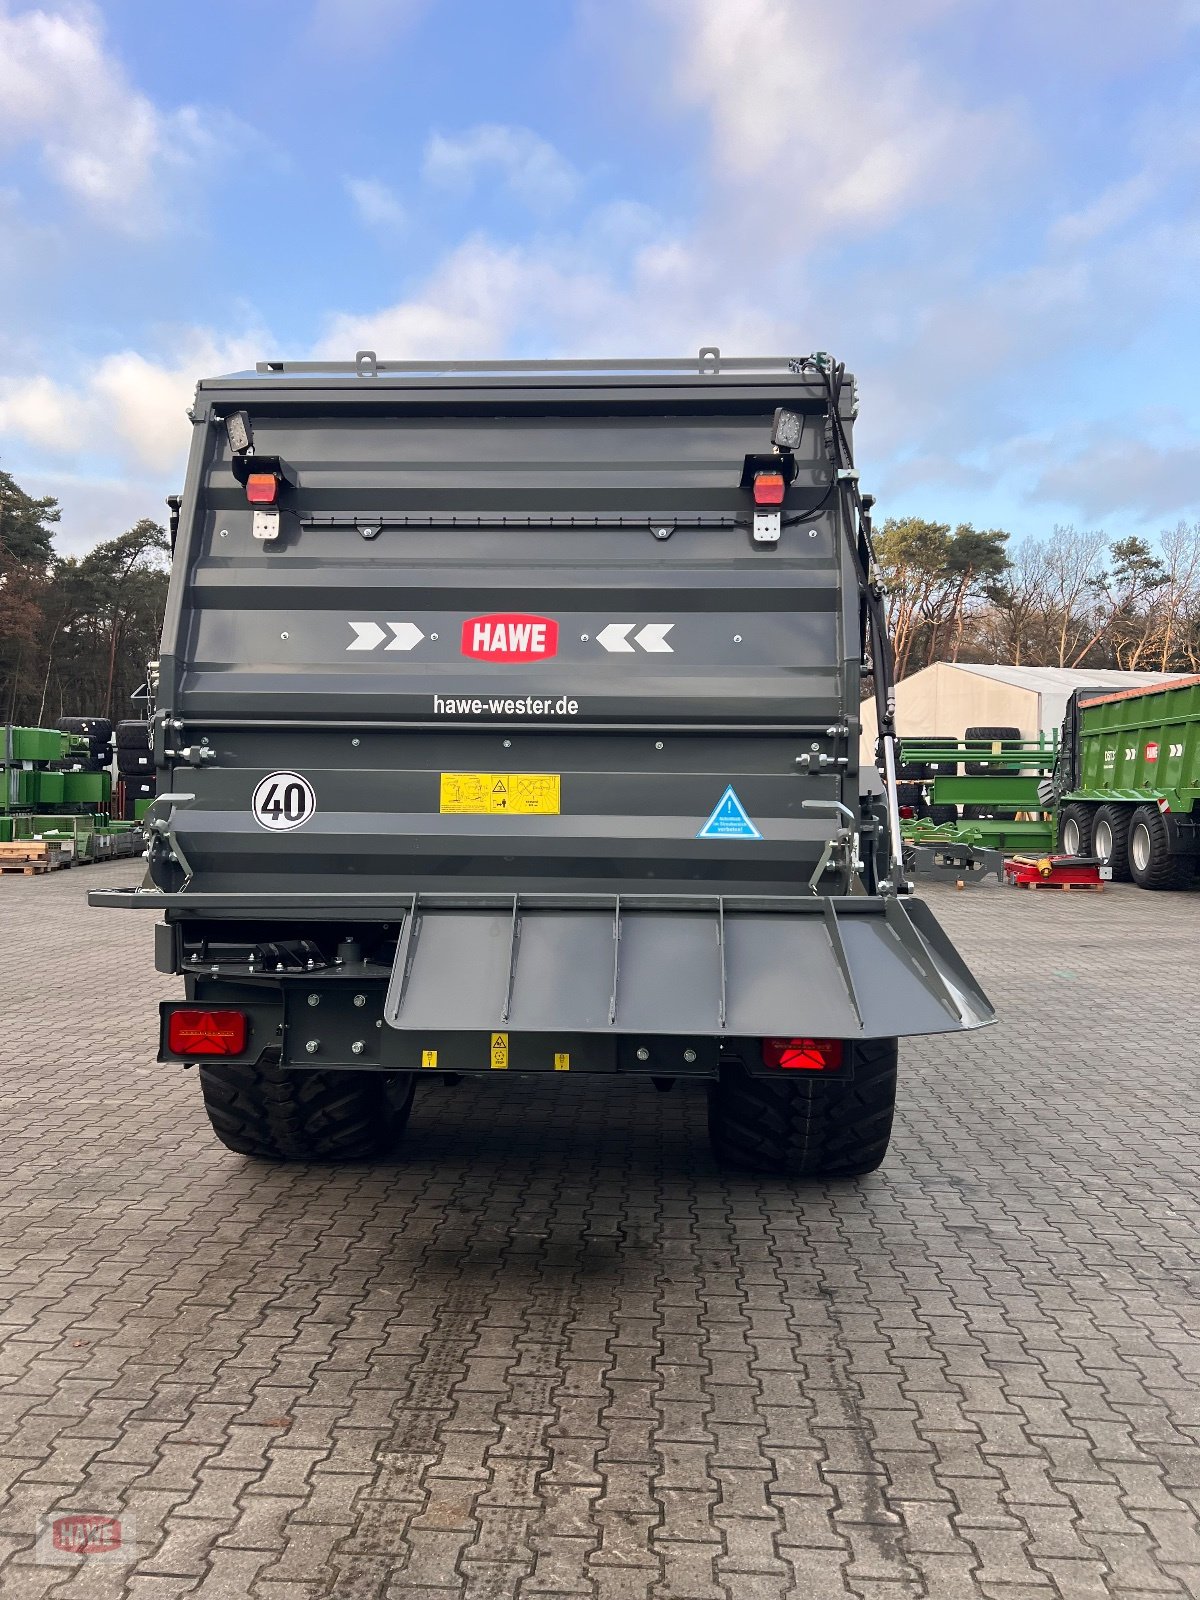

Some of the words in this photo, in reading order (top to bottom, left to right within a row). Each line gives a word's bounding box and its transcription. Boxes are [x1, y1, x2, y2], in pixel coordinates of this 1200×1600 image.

[472, 623, 547, 652] HAWE
[433, 694, 579, 714] hawe-wester.de
[261, 783, 305, 821] 40
